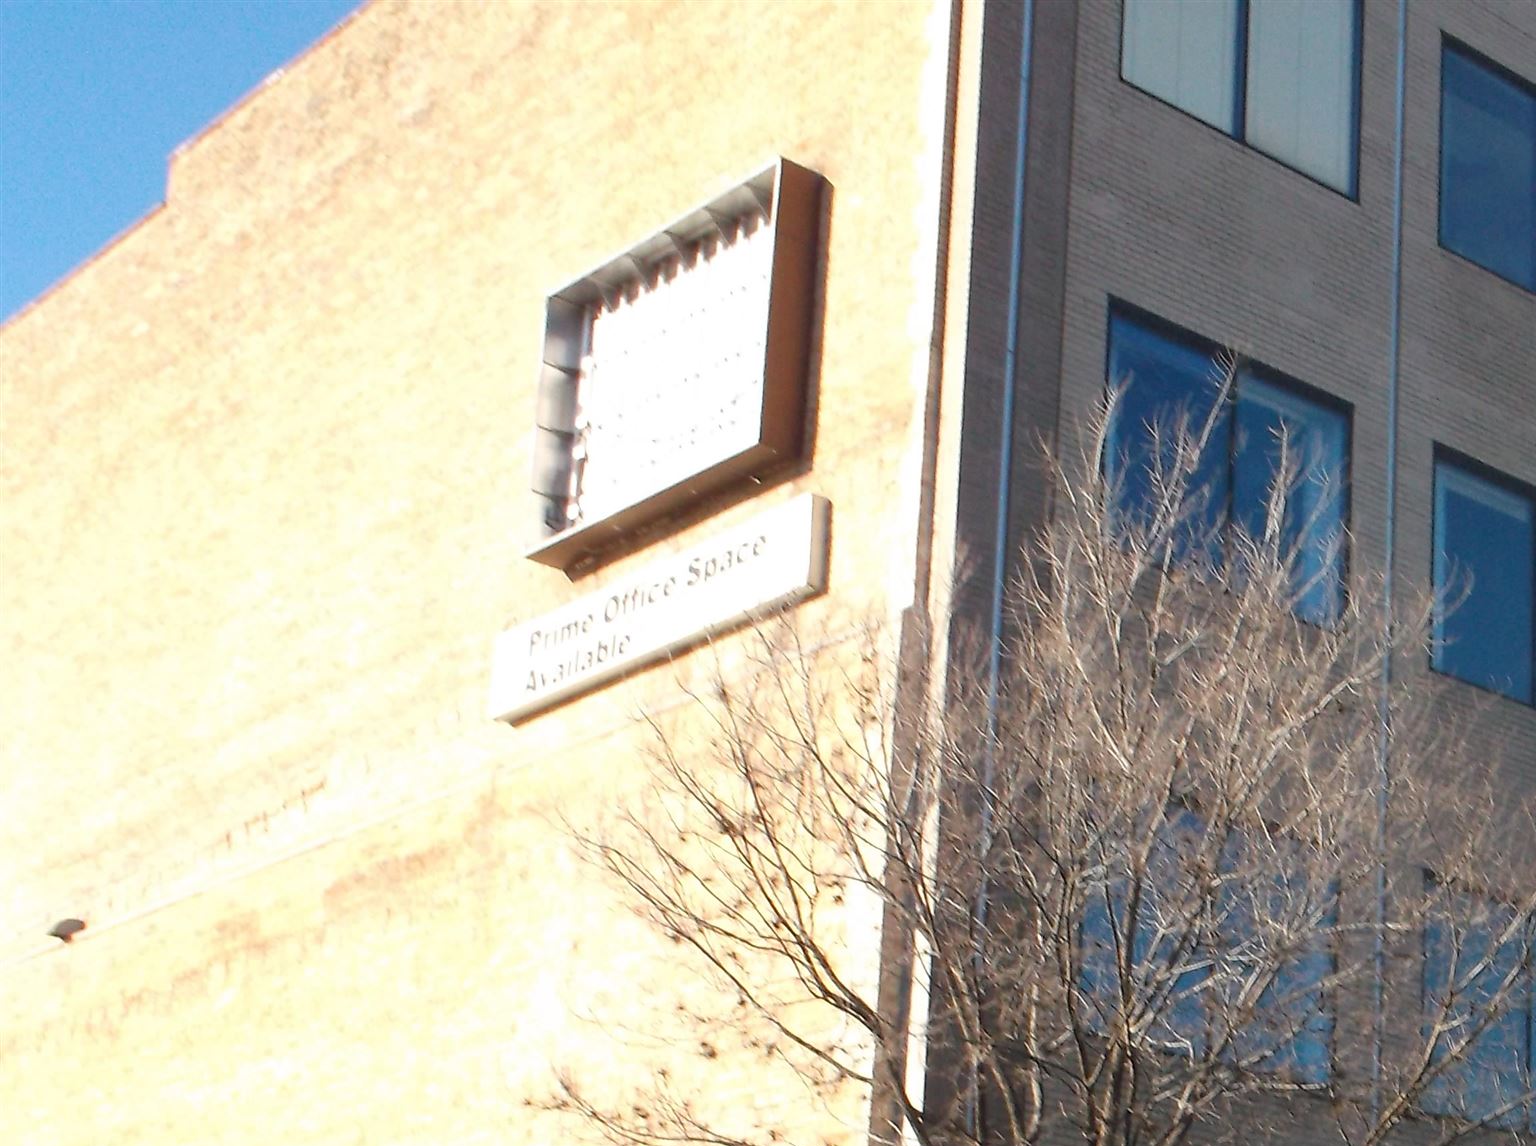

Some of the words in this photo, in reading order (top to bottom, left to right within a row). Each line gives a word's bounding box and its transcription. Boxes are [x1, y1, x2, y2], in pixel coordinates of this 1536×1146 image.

[529, 613, 594, 655] Prime
[604, 576, 676, 623] Office
[687, 535, 766, 586] Space
[525, 635, 631, 691] Available
